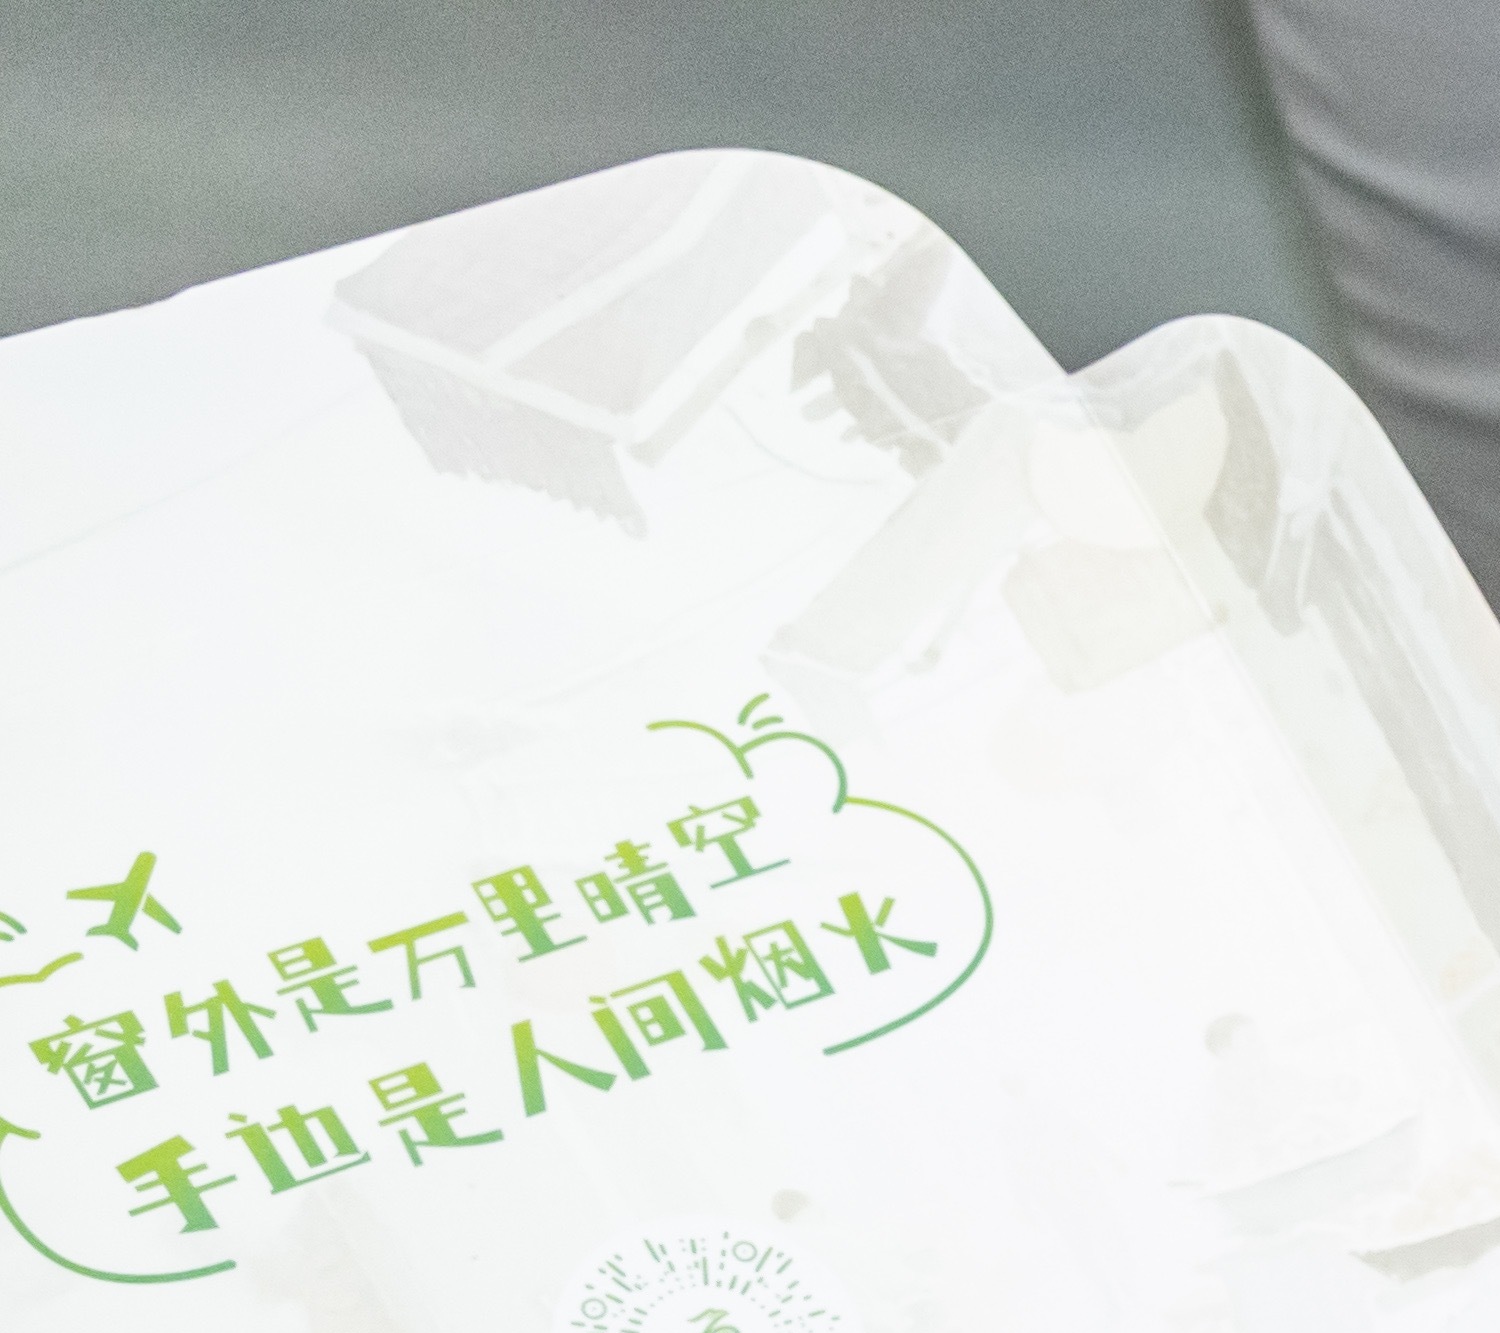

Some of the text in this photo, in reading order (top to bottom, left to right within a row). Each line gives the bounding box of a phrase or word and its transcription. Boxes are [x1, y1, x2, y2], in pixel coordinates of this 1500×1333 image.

[27, 796, 791, 1110] 窗外是万里晴空
[114, 890, 938, 1234] 手边是人间烟火
